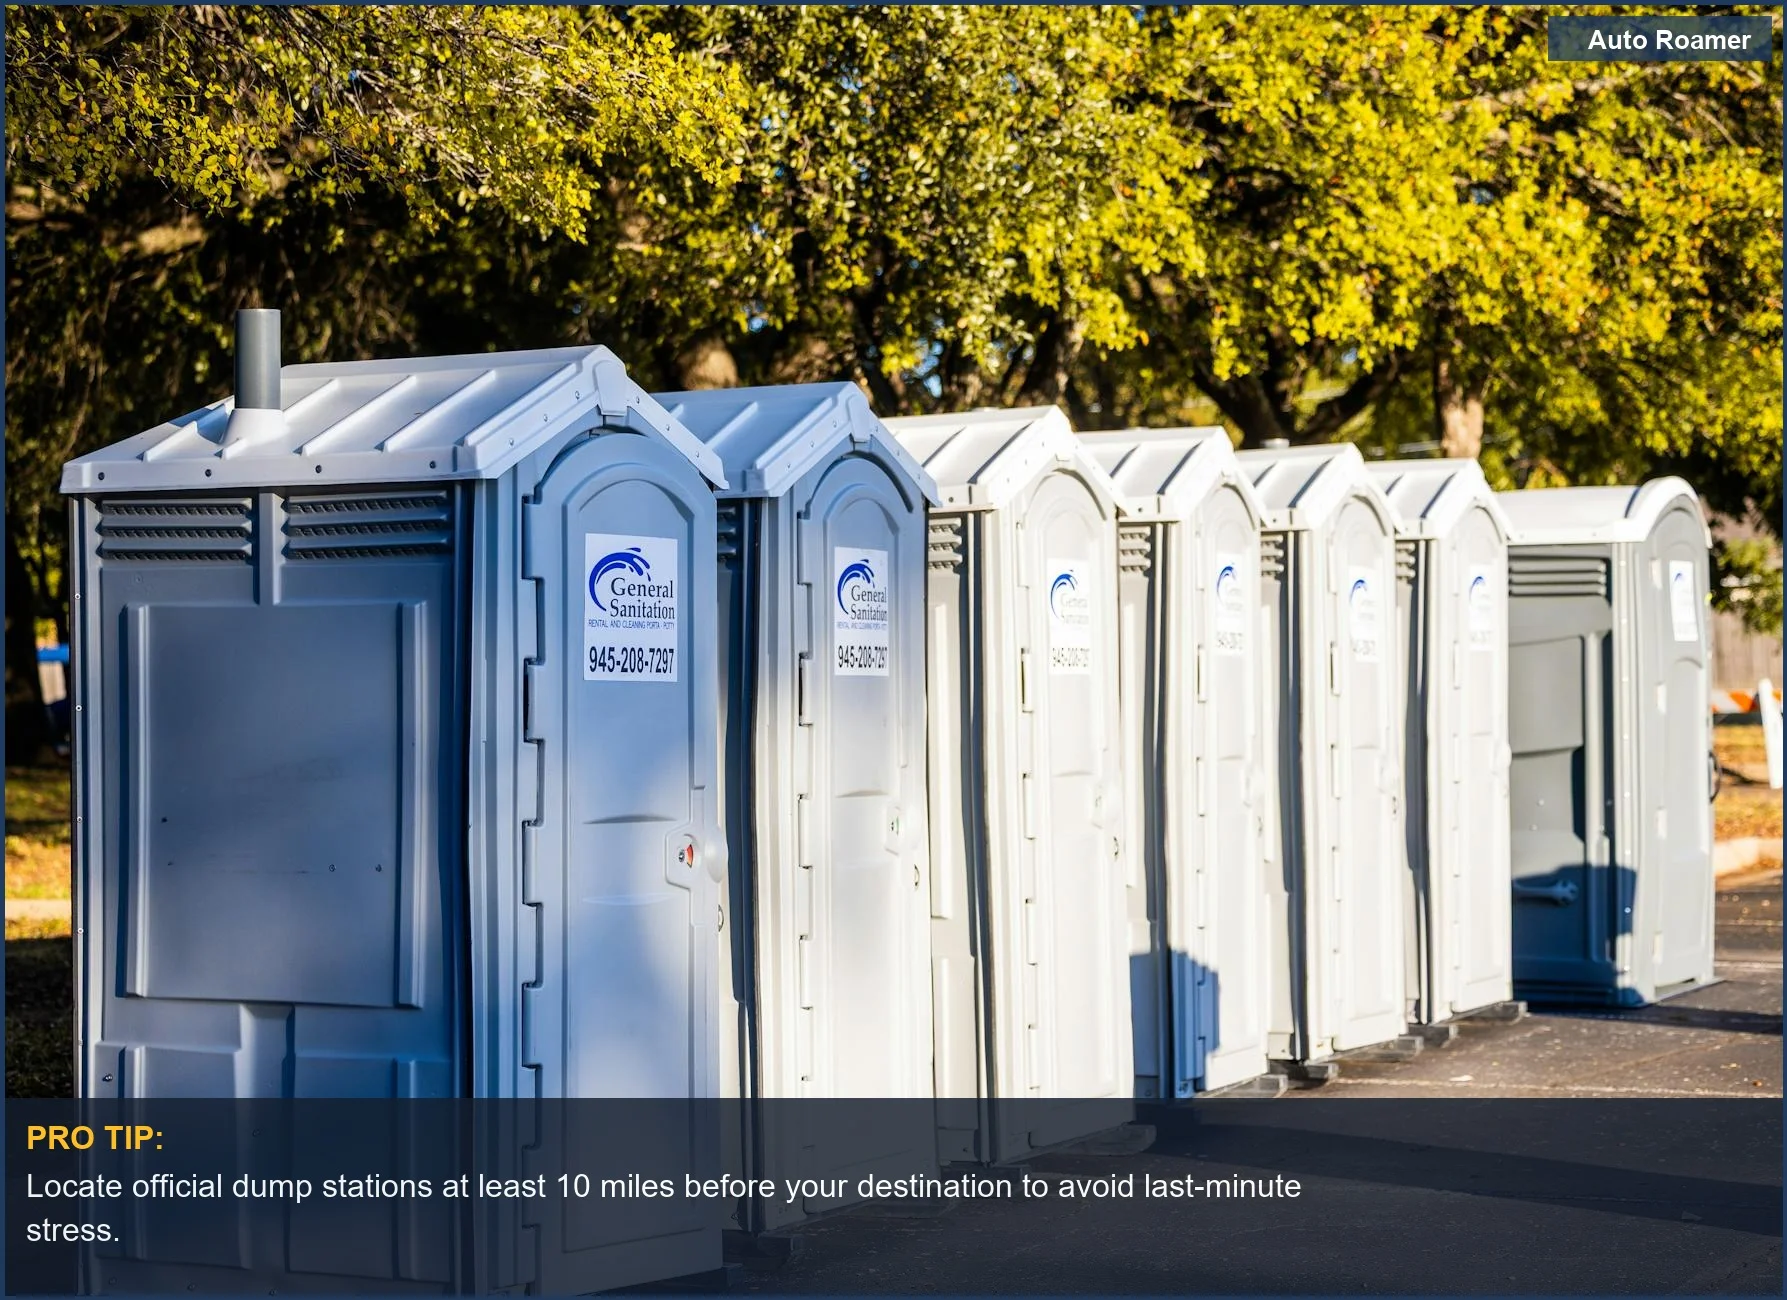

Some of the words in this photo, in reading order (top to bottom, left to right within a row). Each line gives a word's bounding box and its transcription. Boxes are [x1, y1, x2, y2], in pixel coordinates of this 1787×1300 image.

[611, 577, 674, 598] General
[851, 585, 887, 603] General
[610, 598, 675, 619] Sanitation
[850, 604, 888, 622] Sanitation
[589, 619, 608, 628] RENTAL
[610, 620, 621, 628] AND
[622, 620, 646, 629] CLEANING
[589, 646, 675, 674] 945-208-7297
